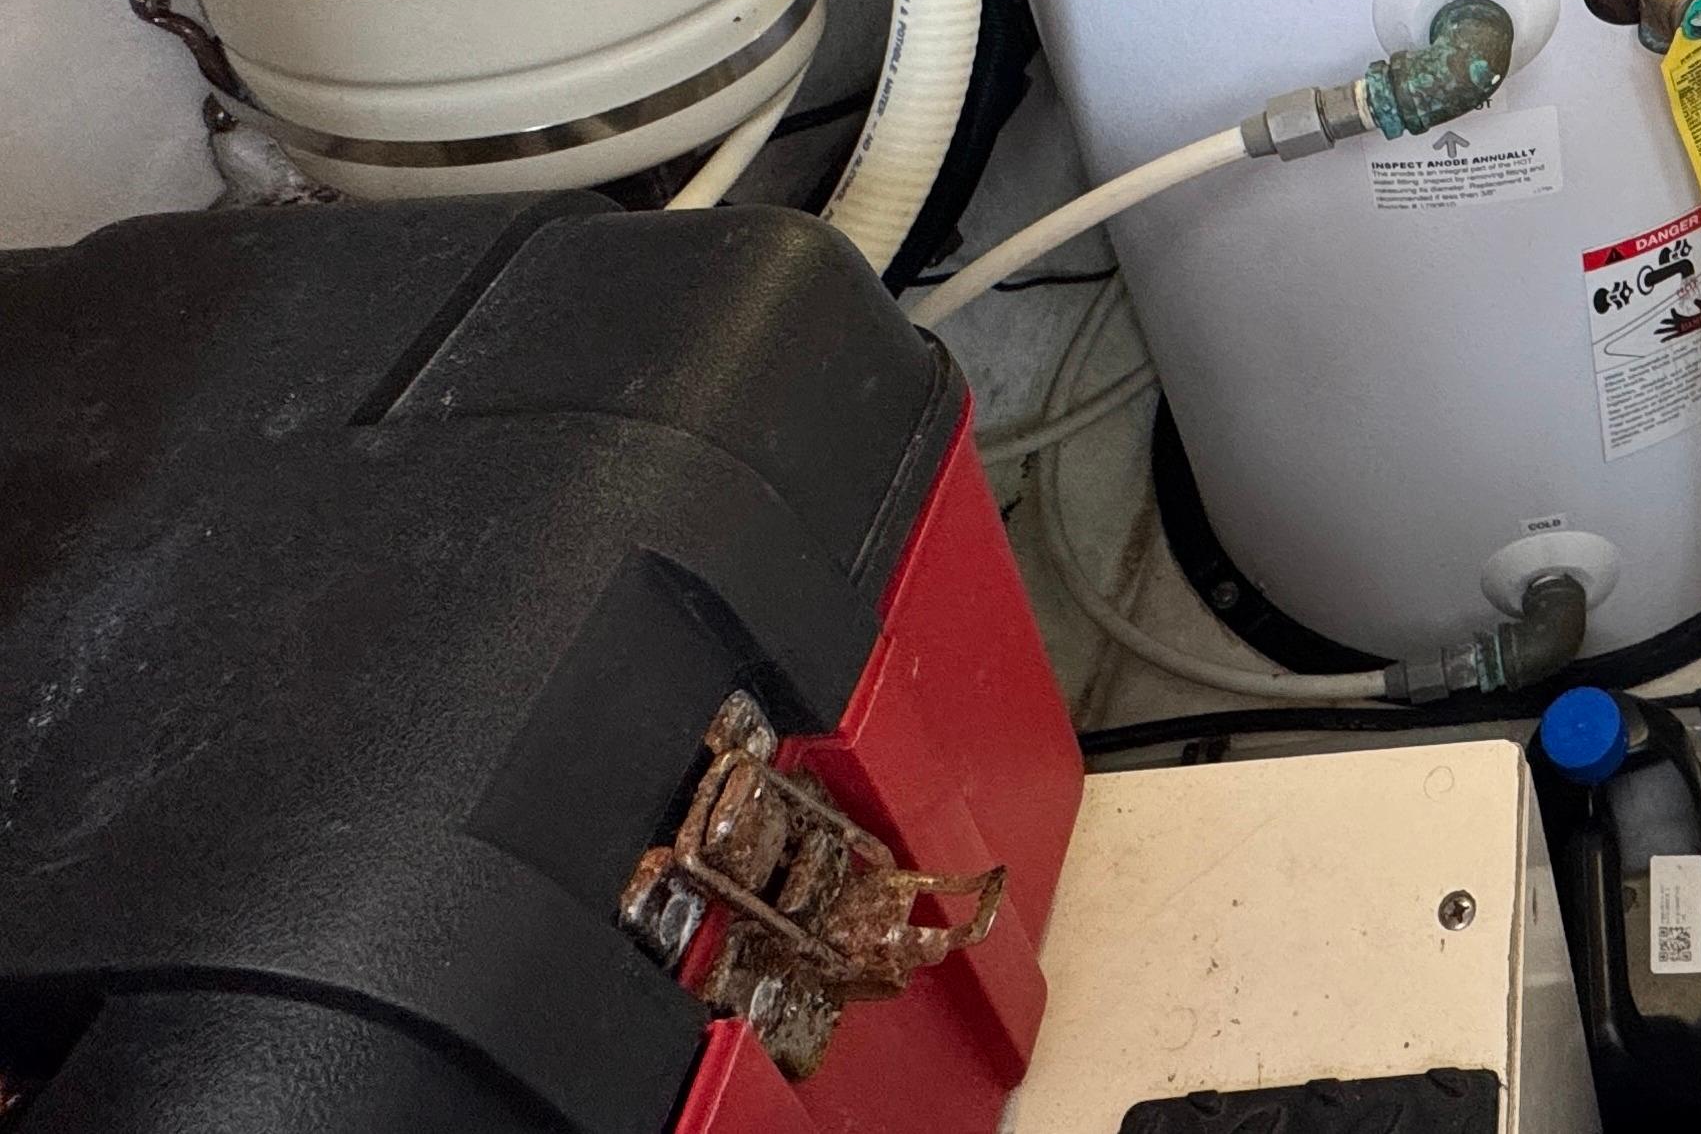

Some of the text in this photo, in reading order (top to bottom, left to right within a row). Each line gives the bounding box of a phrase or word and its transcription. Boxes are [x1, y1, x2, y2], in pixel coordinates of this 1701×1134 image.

[889, 20, 907, 75] POTABLE
[1427, 158, 1468, 168] ANODE
[1472, 148, 1536, 164] ANNUALLY
[1513, 158, 1532, 166] HOT
[1636, 215, 1699, 251] DANGER
[1528, 520, 1561, 530] COLD
